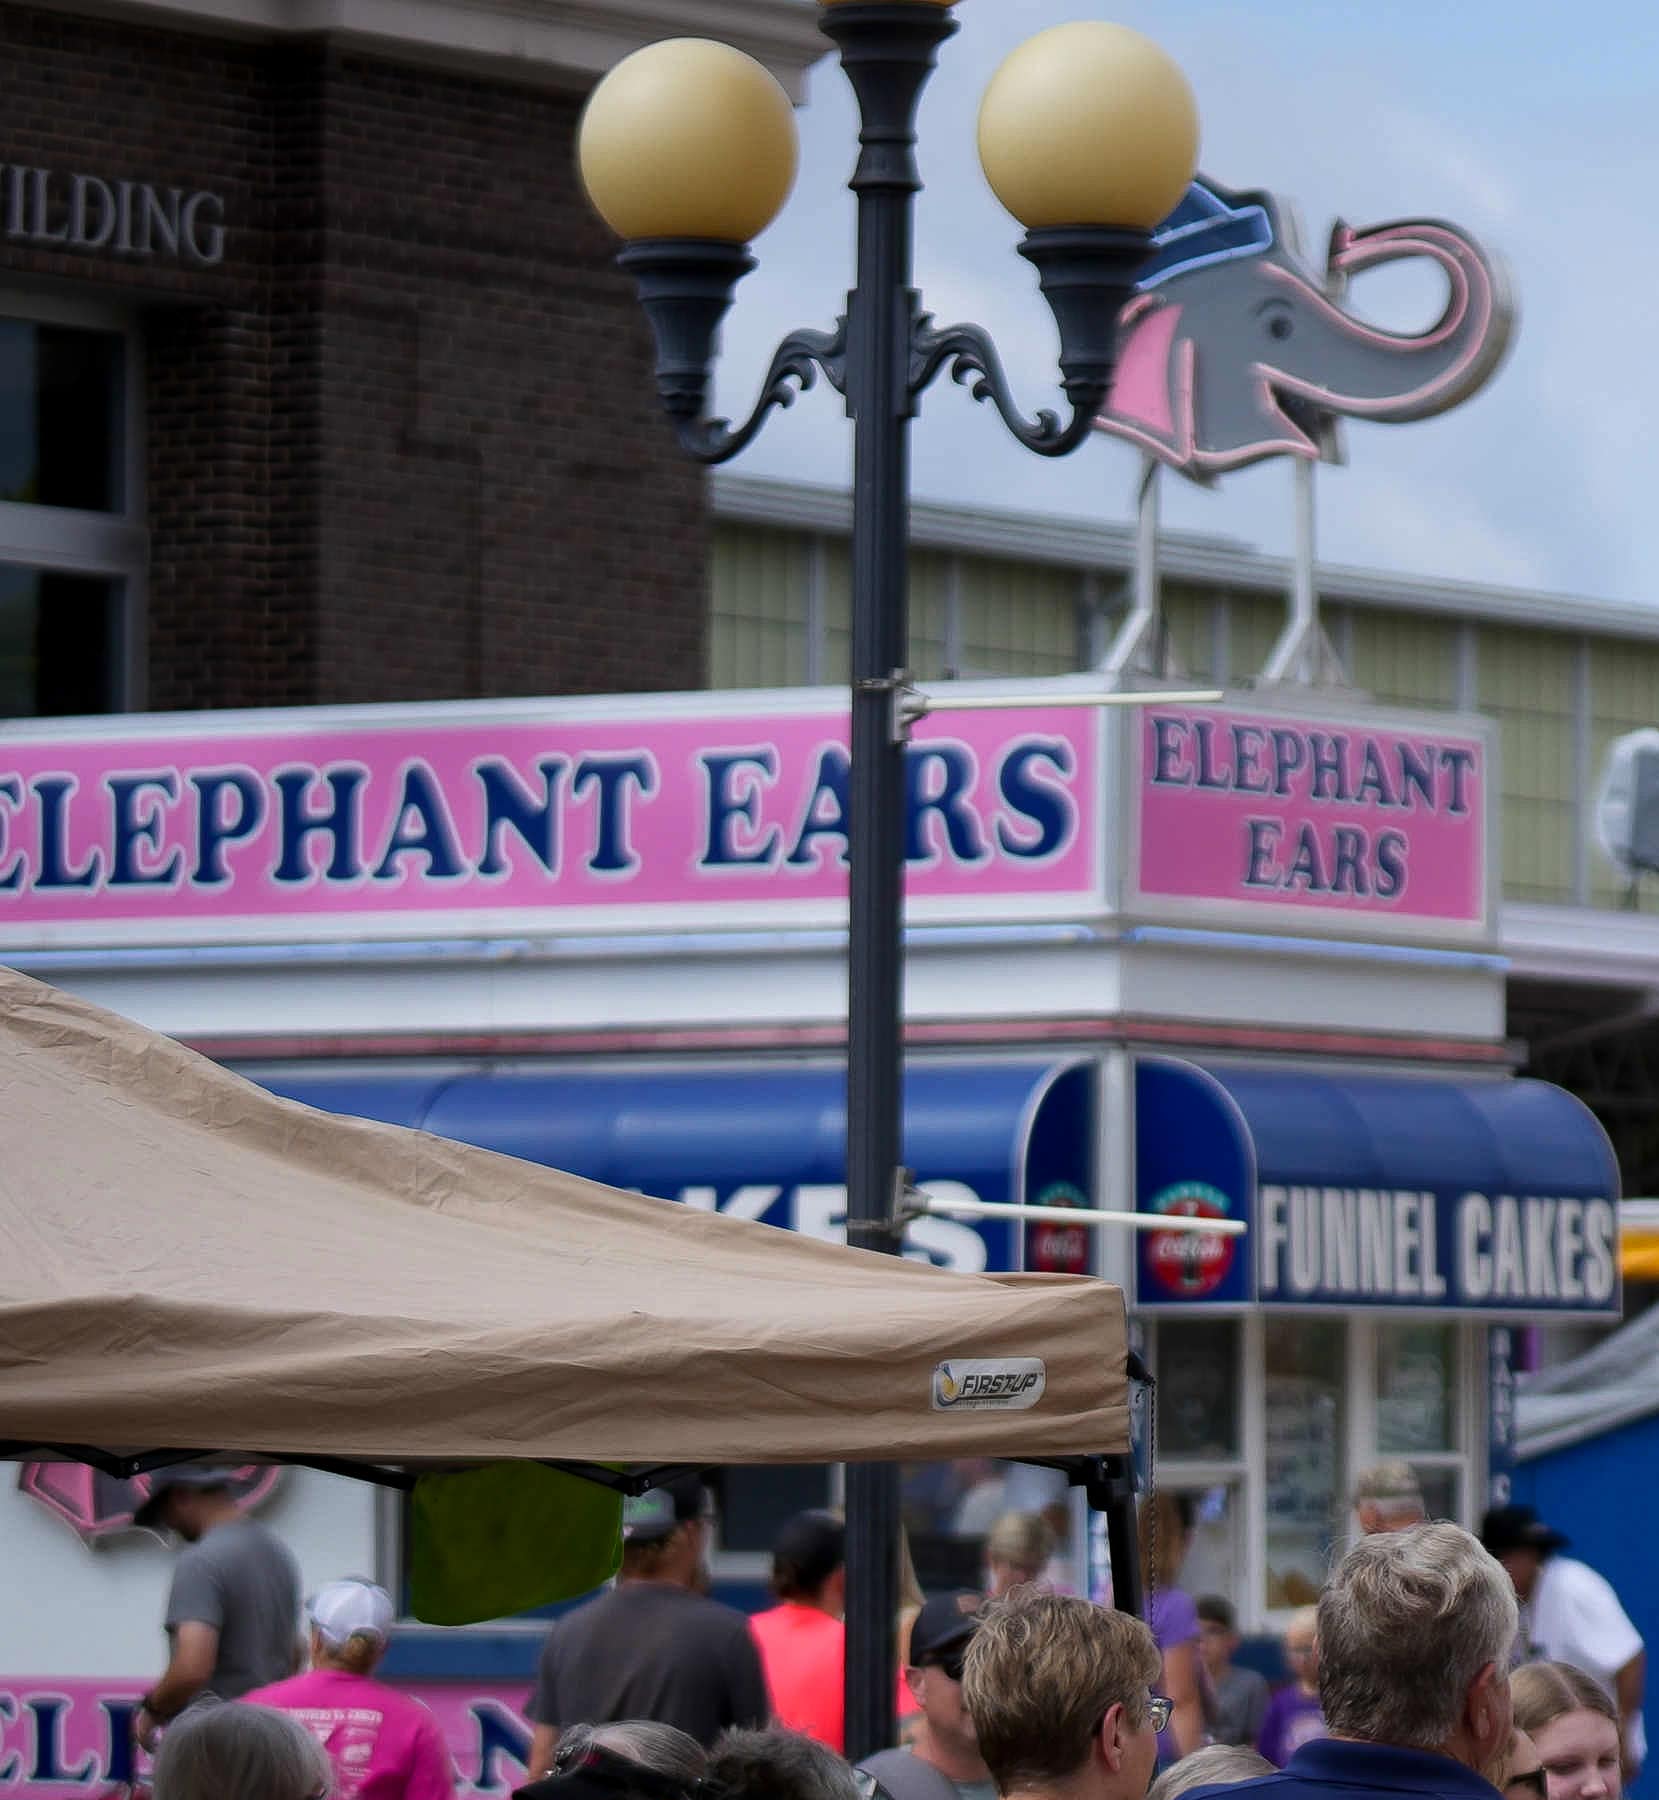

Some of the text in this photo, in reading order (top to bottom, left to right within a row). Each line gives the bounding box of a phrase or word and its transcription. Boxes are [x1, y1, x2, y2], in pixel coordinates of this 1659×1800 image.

[0, 163, 226, 265] ILDING
[1152, 716, 1475, 814] ELEPHANT
[1245, 817, 1410, 898] EARS
[1260, 1183, 1615, 1301] FUNNEL CAKES
